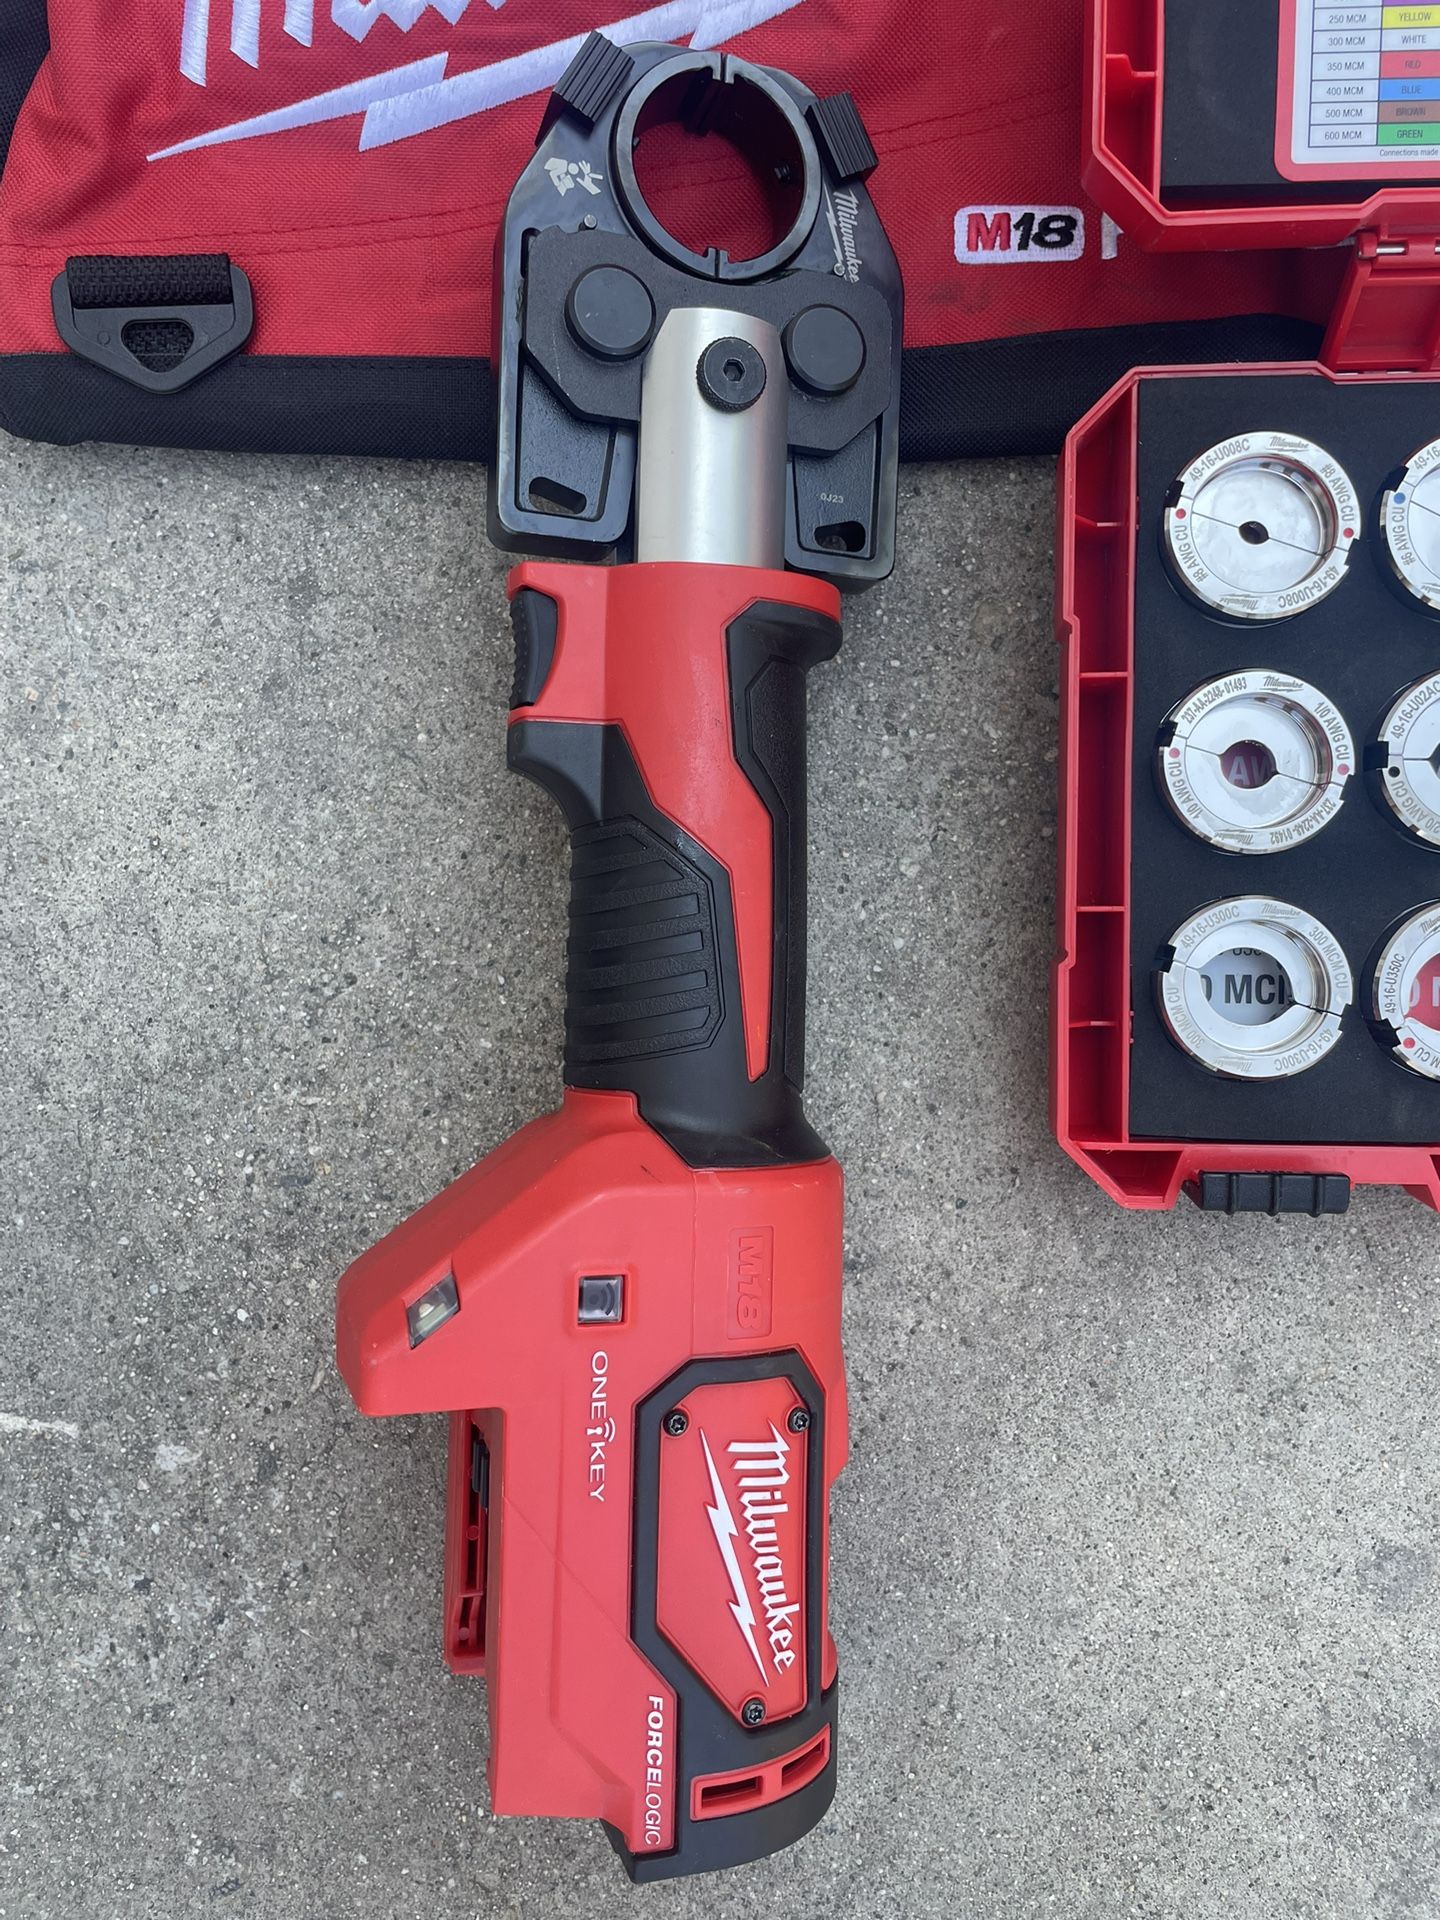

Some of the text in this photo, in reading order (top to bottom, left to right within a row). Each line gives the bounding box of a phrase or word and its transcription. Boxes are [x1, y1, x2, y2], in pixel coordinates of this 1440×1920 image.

[1329, 14, 1367, 24] 250 MCM
[1399, 12, 1432, 22] YELLOW
[1328, 36, 1366, 46] 300 MCM
[1401, 35, 1427, 44] WHITE
[1327, 61, 1365, 71] 350 MCM
[1404, 60, 1421, 69] RED
[1326, 86, 1364, 96] 400 MCM
[1401, 85, 1423, 94] BLUE
[1325, 108, 1363, 118] 500 MCM
[1396, 107, 1426, 117] BROWN
[1324, 130, 1362, 140] 600 MCM
[1397, 129, 1424, 139] GREEN
[1380, 147, 1439, 157] Connections made
[833, 188, 862, 284] Milwaukee
[966, 212, 1078, 251] M18
[1269, 435, 1309, 449] Milwaukee
[1189, 438, 1251, 483] 49-16-U008C
[1320, 463, 1355, 523] #8 AWG CU
[1392, 507, 1416, 566] #6 AWG CU
[1174, 524, 1208, 583] #8 AWG CU
[1278, 565, 1340, 609] 49-16-U008C
[1262, 675, 1303, 689] Milwaukee
[1324, 717, 1345, 743] AWG
[1335, 743, 1350, 760] CU
[1168, 761, 1183, 779] CU
[1172, 778, 1196, 808] AWG
[1391, 780, 1405, 799] CU
[1402, 796, 1425, 823] AWG
[1180, 905, 1240, 949] 49-16-U300C
[1308, 926, 1350, 989] 300 MCM CU
[1384, 953, 1405, 1014] 49-16-U350C
[1167, 987, 1205, 1050] 300 MCM CU
[1274, 1028, 1334, 1072] 49-16-U300C
[1414, 1046, 1431, 1063] CU
[736, 1235, 764, 1330] M18
[726, 1418, 801, 1676] Milwaukee
[644, 1695, 663, 1847] FORCELOGIC
